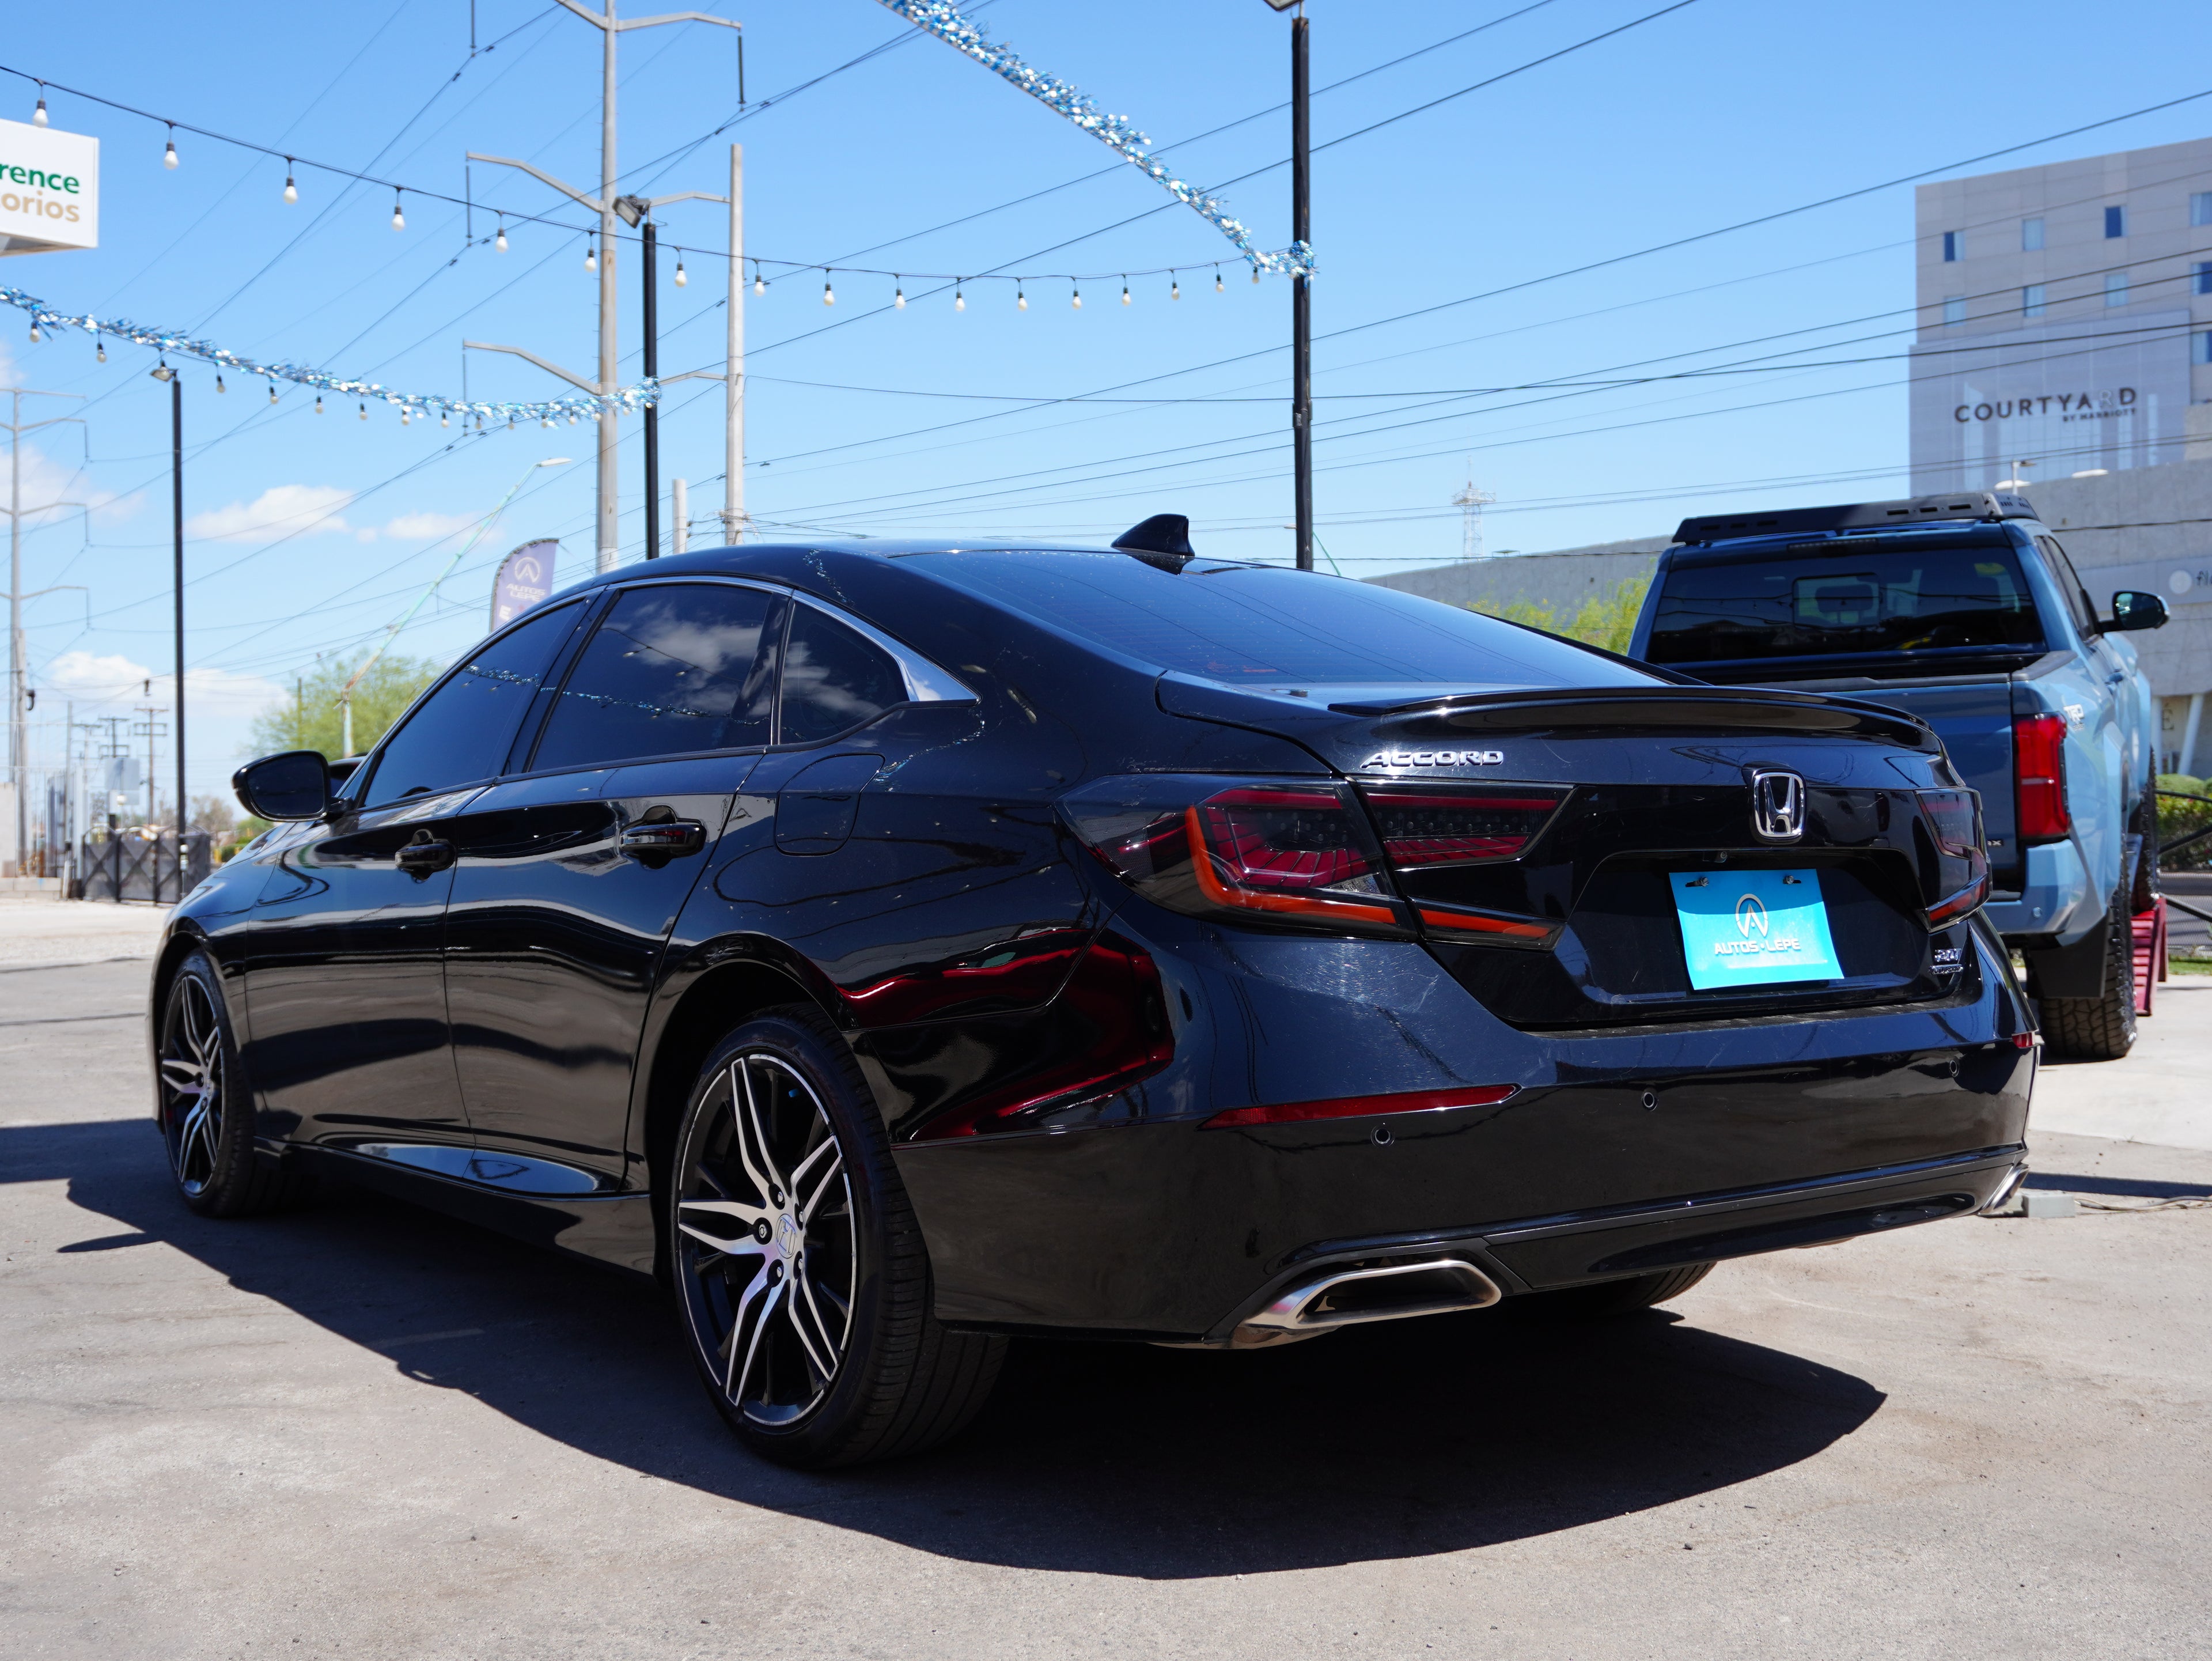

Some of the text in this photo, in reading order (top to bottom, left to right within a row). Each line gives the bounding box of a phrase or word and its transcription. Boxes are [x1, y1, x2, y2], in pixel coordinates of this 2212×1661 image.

[1, 190, 79, 222] orios
[506, 583, 546, 596] AUTOS
[1360, 750, 1504, 769] ACCORD
